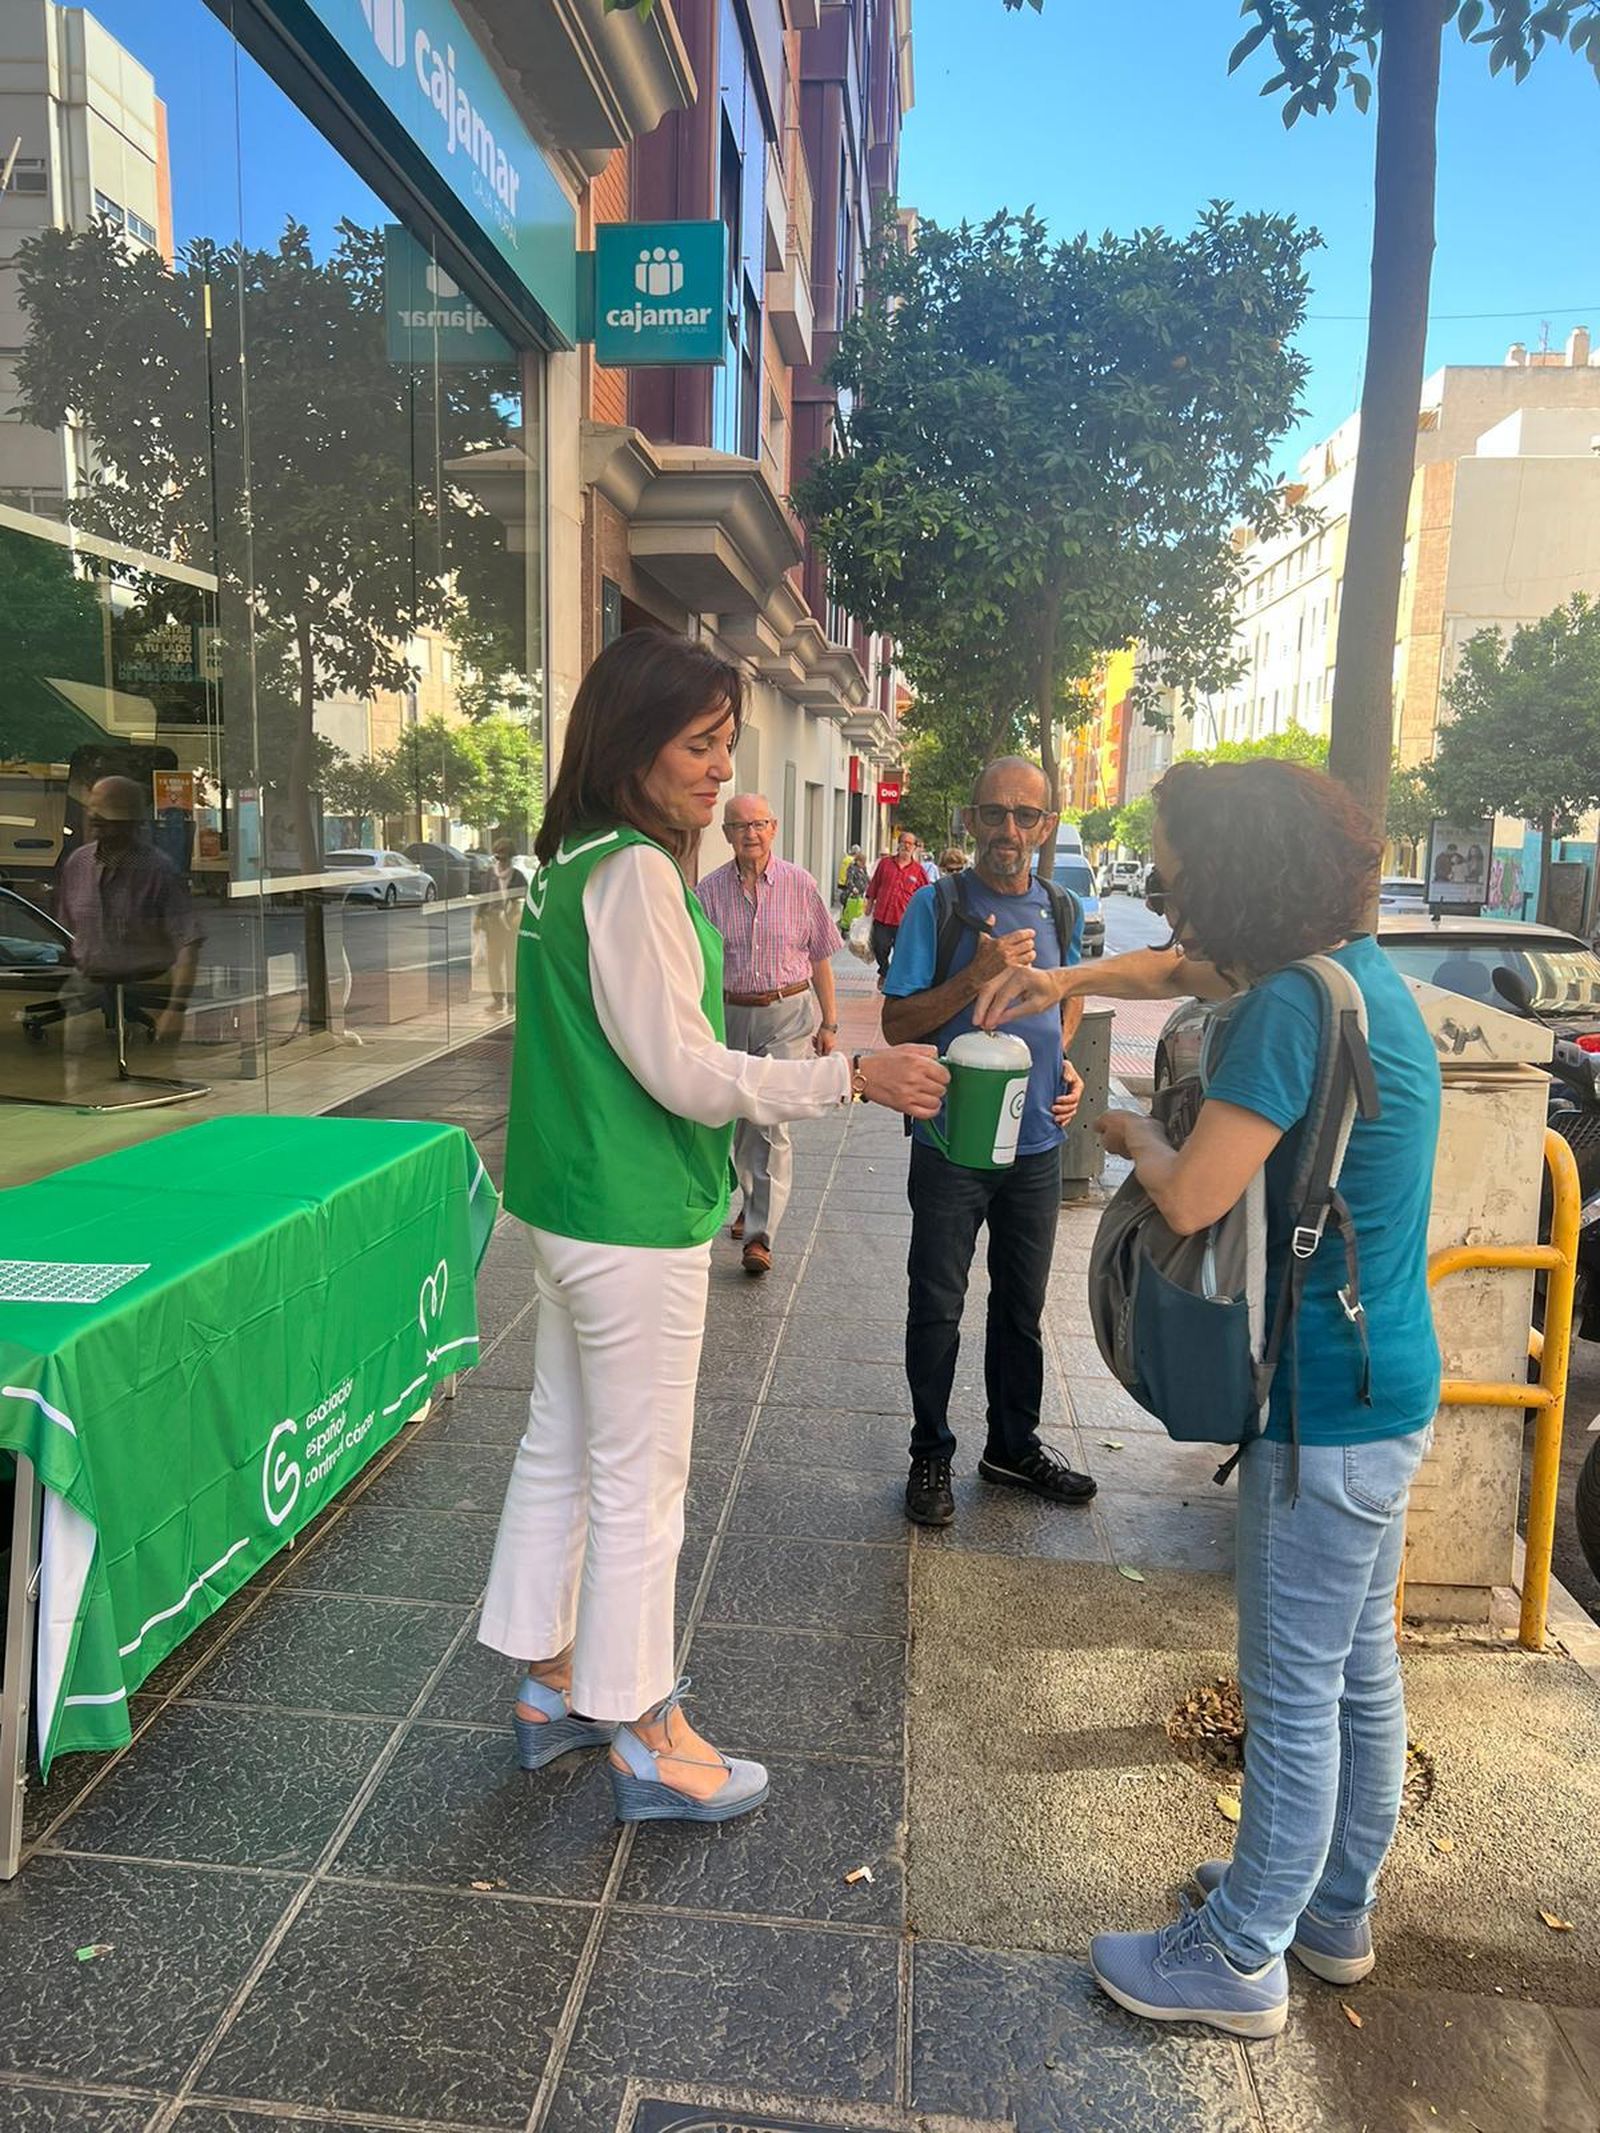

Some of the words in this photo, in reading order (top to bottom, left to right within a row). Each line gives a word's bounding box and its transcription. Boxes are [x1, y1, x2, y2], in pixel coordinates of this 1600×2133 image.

[415, 28, 520, 218] cajamar
[606, 302, 712, 333] cajamar
[134, 643, 144, 653] A
[144, 643, 159, 653] TU
[162, 643, 192, 653] LADO
[162, 653, 192, 664] PARA
